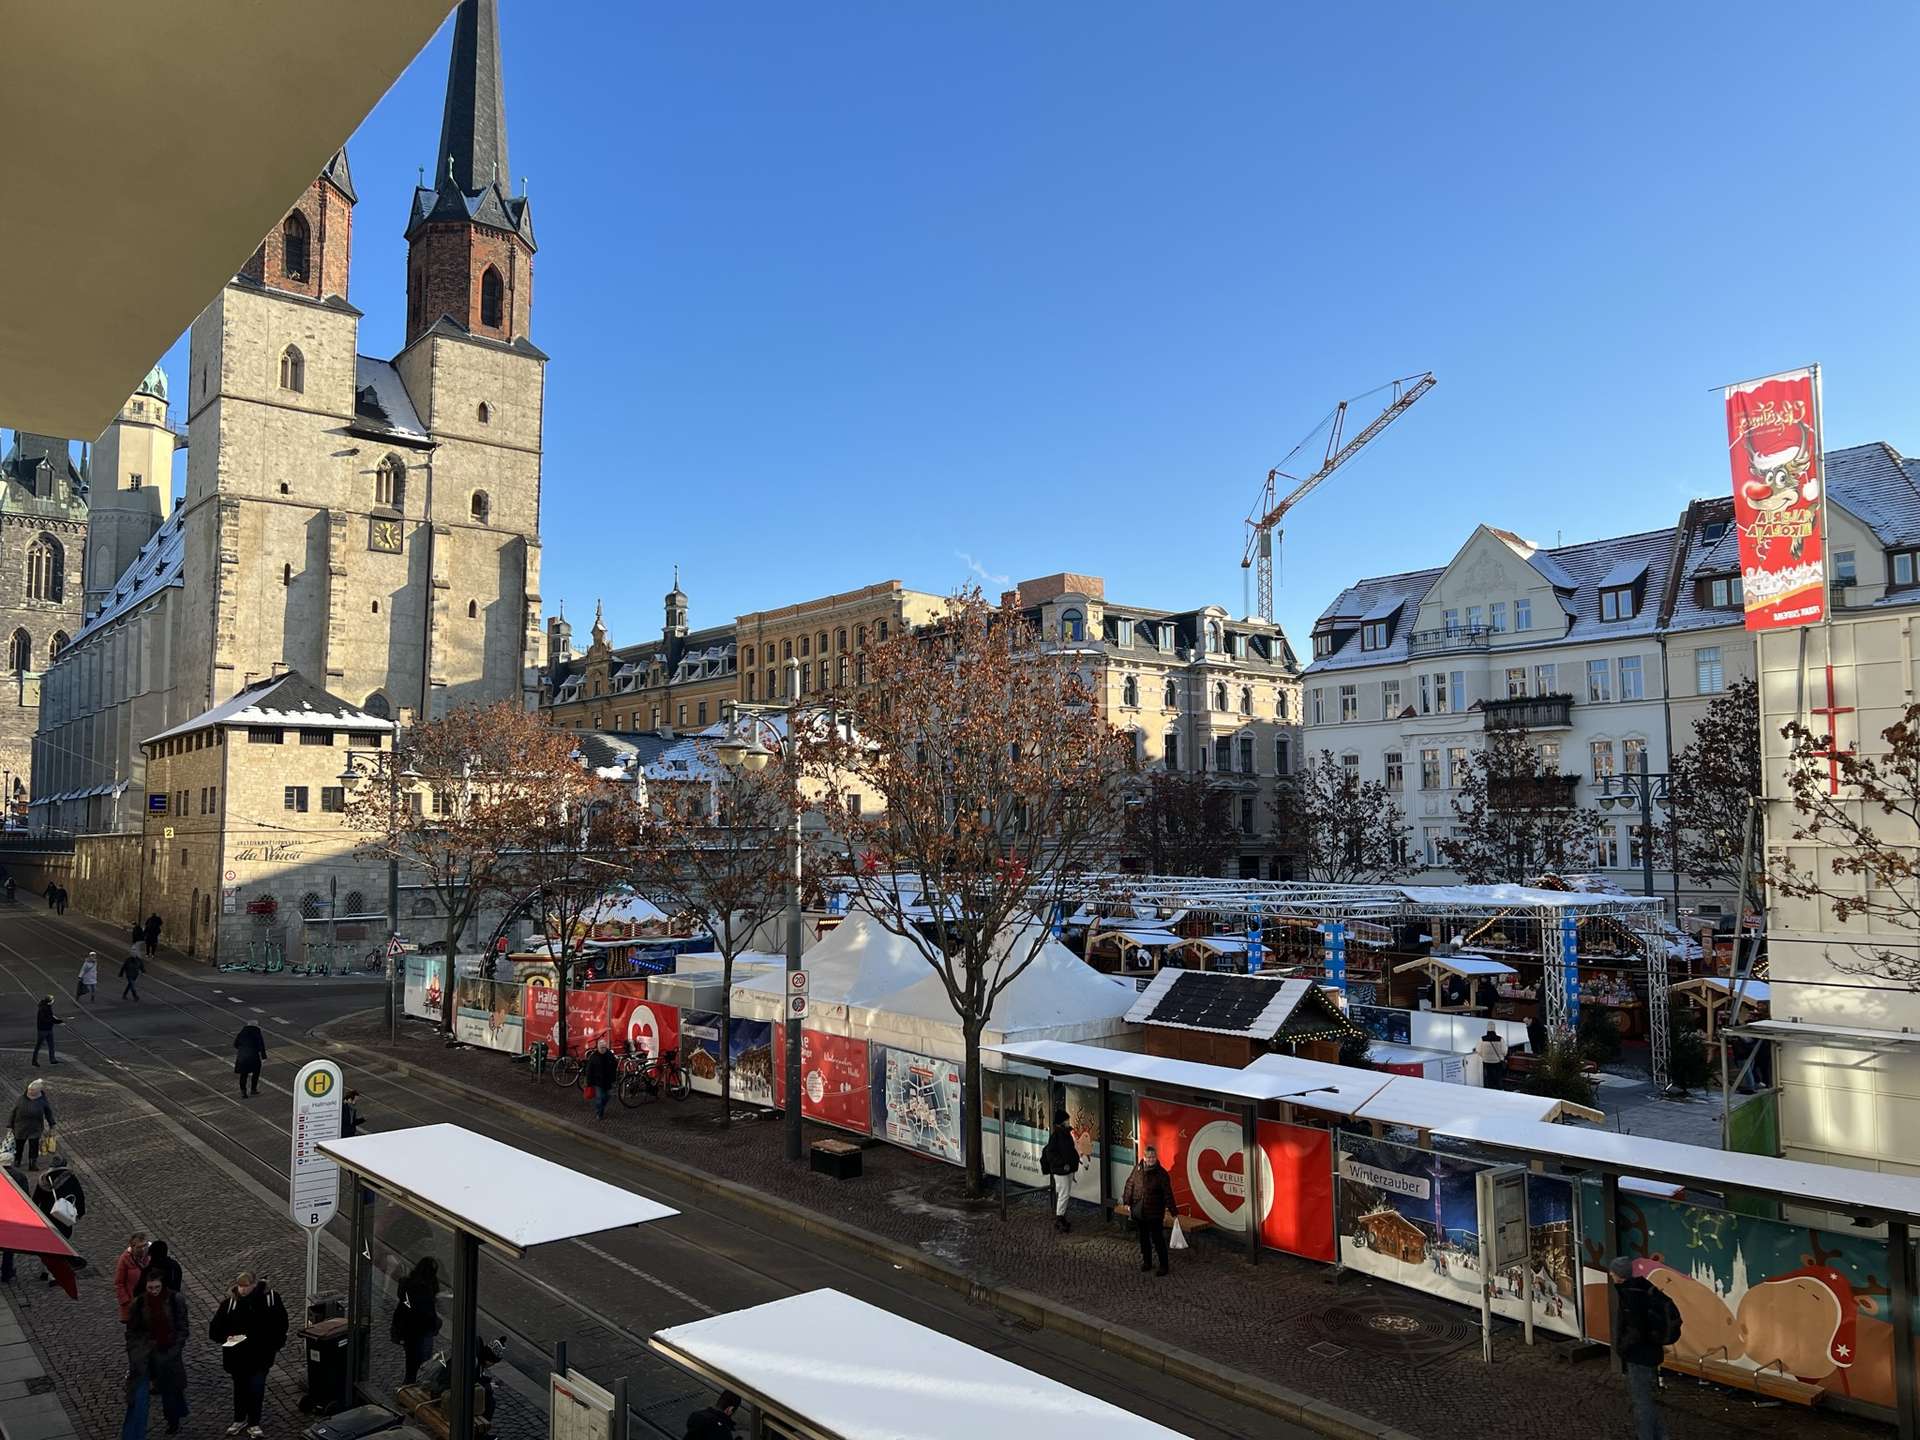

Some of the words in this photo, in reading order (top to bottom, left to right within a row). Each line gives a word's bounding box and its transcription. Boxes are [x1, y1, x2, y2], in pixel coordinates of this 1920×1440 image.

[795, 976, 803, 985] 20
[537, 991, 558, 1004] Halle
[313, 1075, 326, 1092] H
[1218, 1172, 1244, 1184] VERLIE
[1349, 1163, 1421, 1193] Winterzauber
[310, 1213, 319, 1225] B
